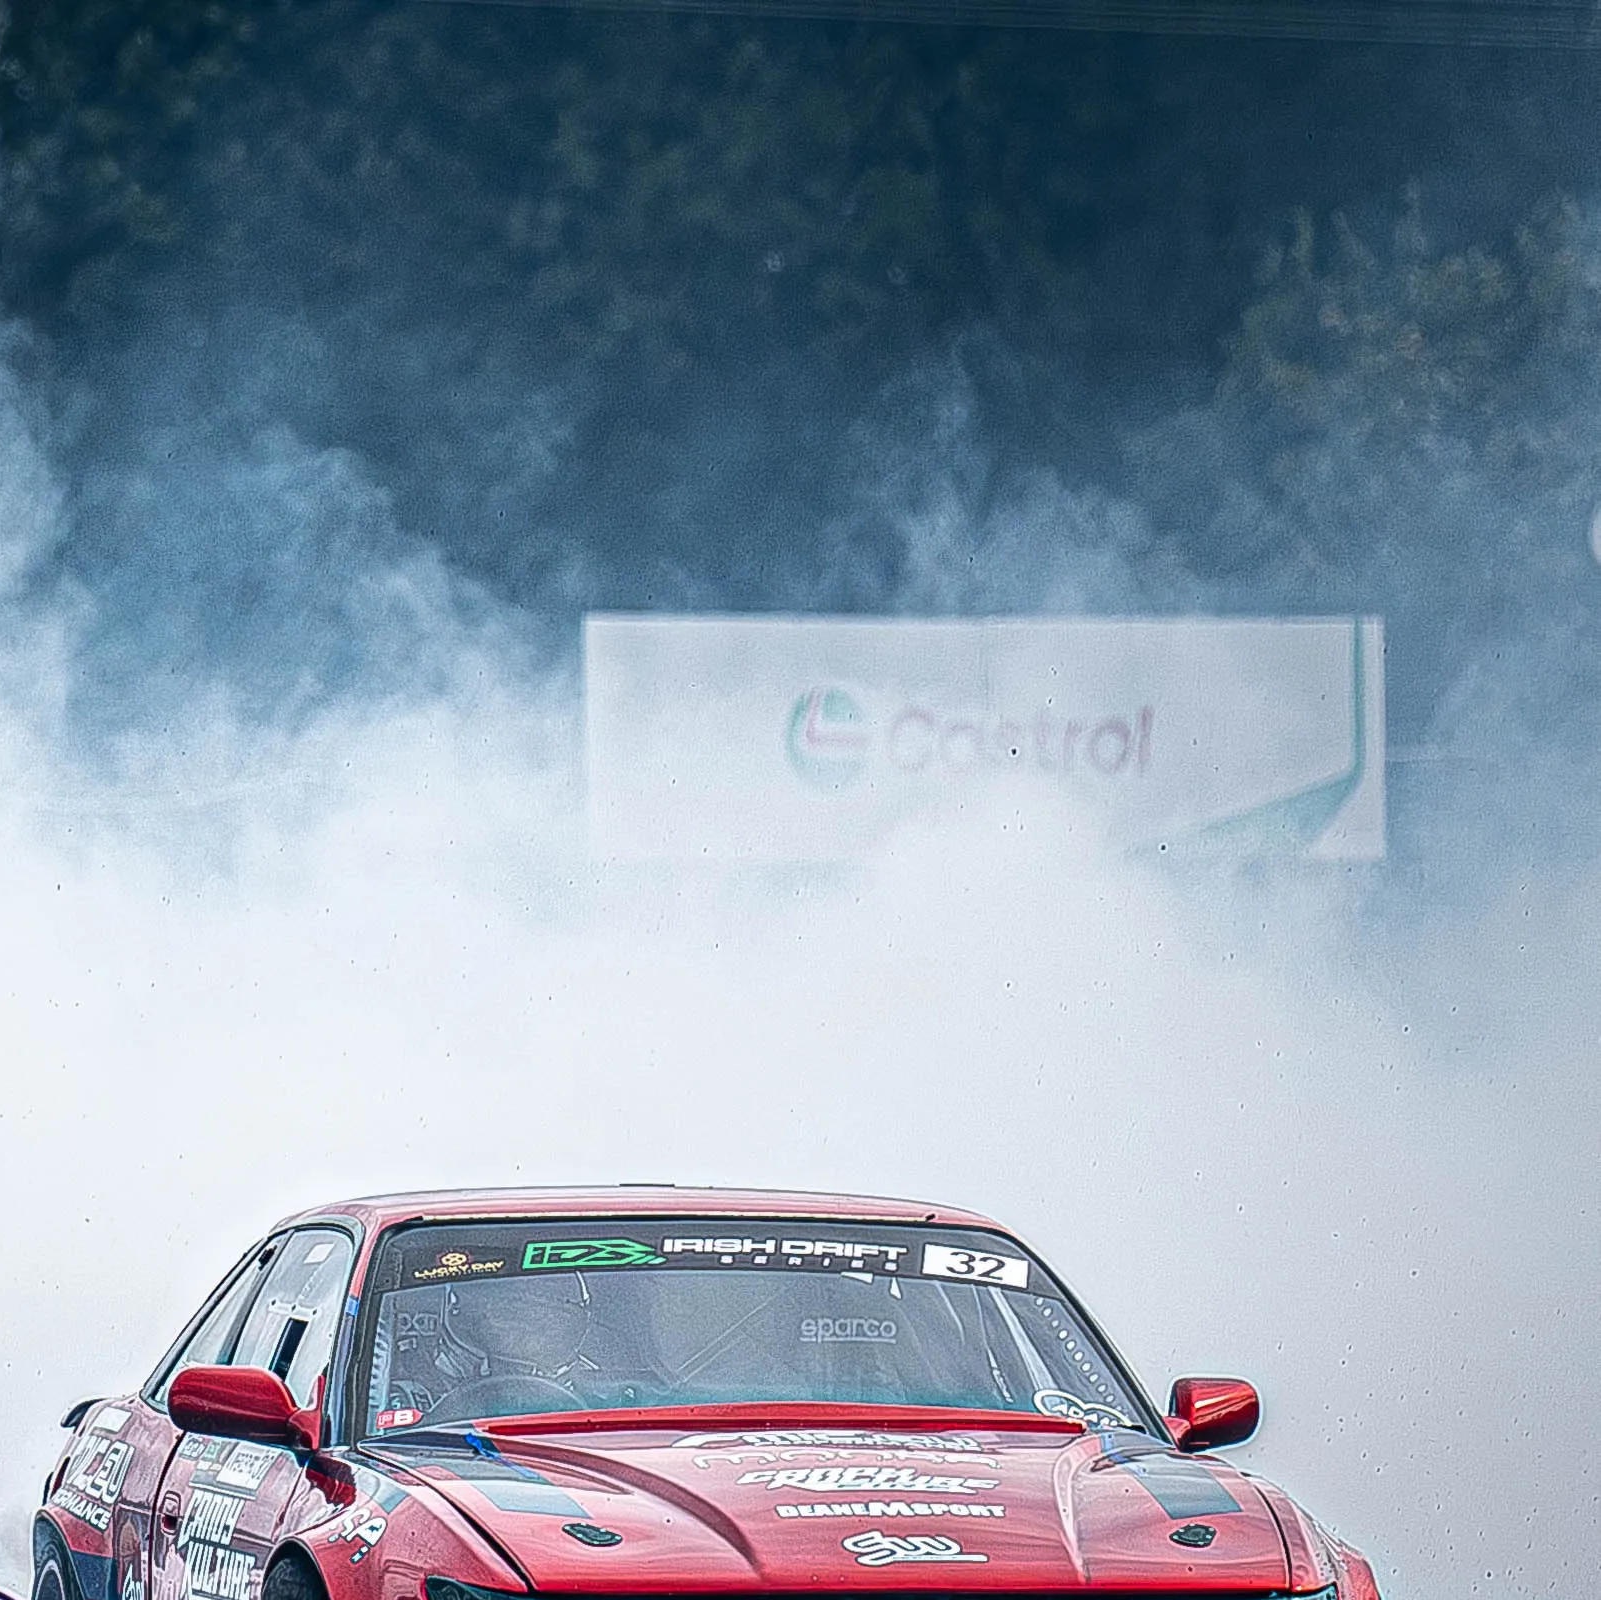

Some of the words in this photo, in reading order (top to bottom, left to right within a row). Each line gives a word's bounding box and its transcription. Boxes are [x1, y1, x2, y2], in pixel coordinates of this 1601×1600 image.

[887, 704, 1153, 774] Castrol
[664, 1239, 776, 1254] IRISH
[781, 1240, 907, 1256] DRIFT
[414, 1265, 467, 1278] LUCKY
[947, 1252, 1006, 1280] 32
[801, 1318, 896, 1342] sparco
